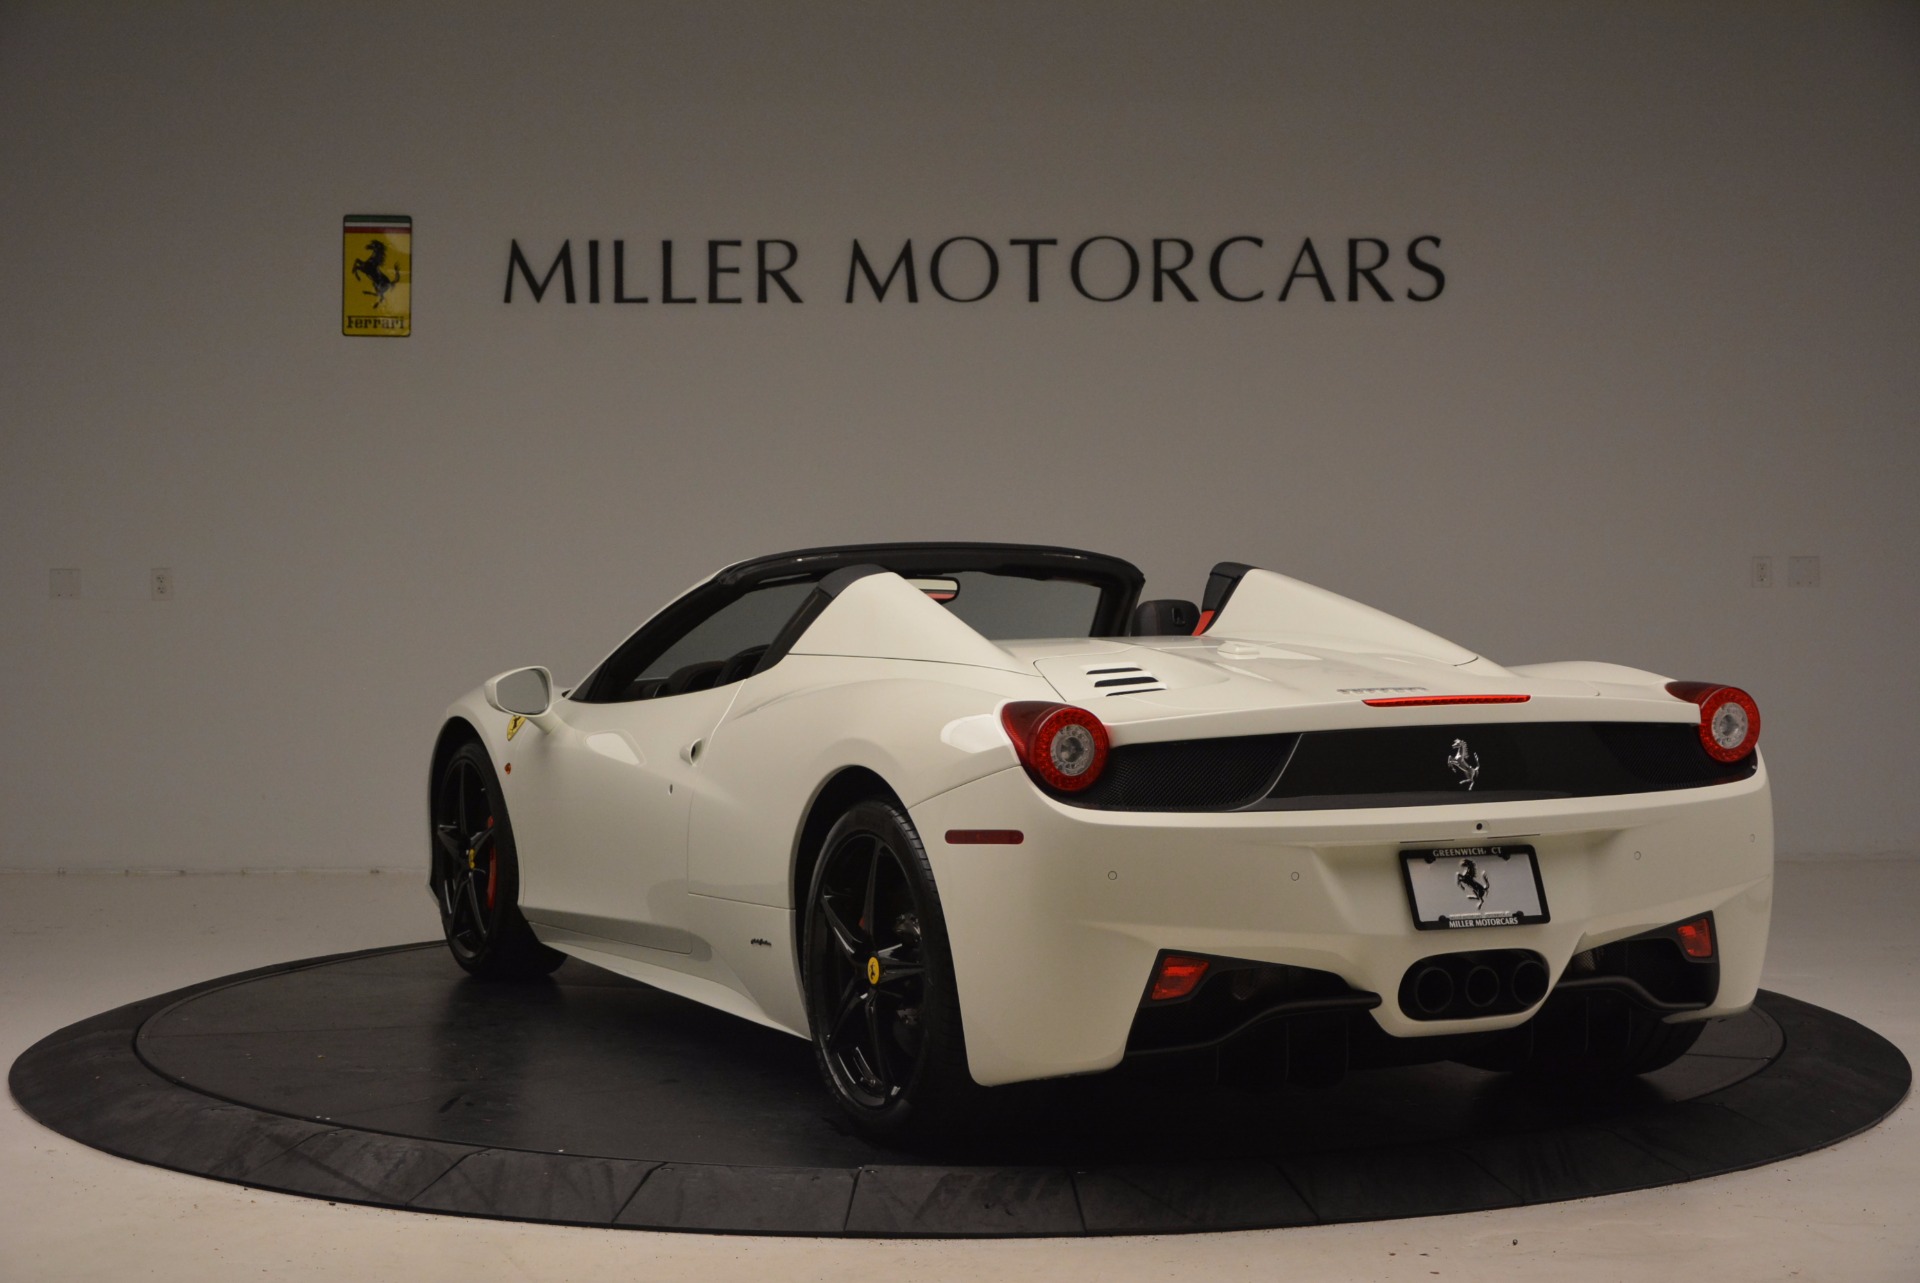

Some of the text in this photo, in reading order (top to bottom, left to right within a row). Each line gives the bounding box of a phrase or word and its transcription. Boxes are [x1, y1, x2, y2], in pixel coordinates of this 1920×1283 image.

[503, 235, 1446, 304] MILLER MOTORCARS
[346, 315, 405, 329] Ferrari
[1491, 846, 1502, 854] CT
[1449, 917, 1519, 928] MILLER MOTORCARS
